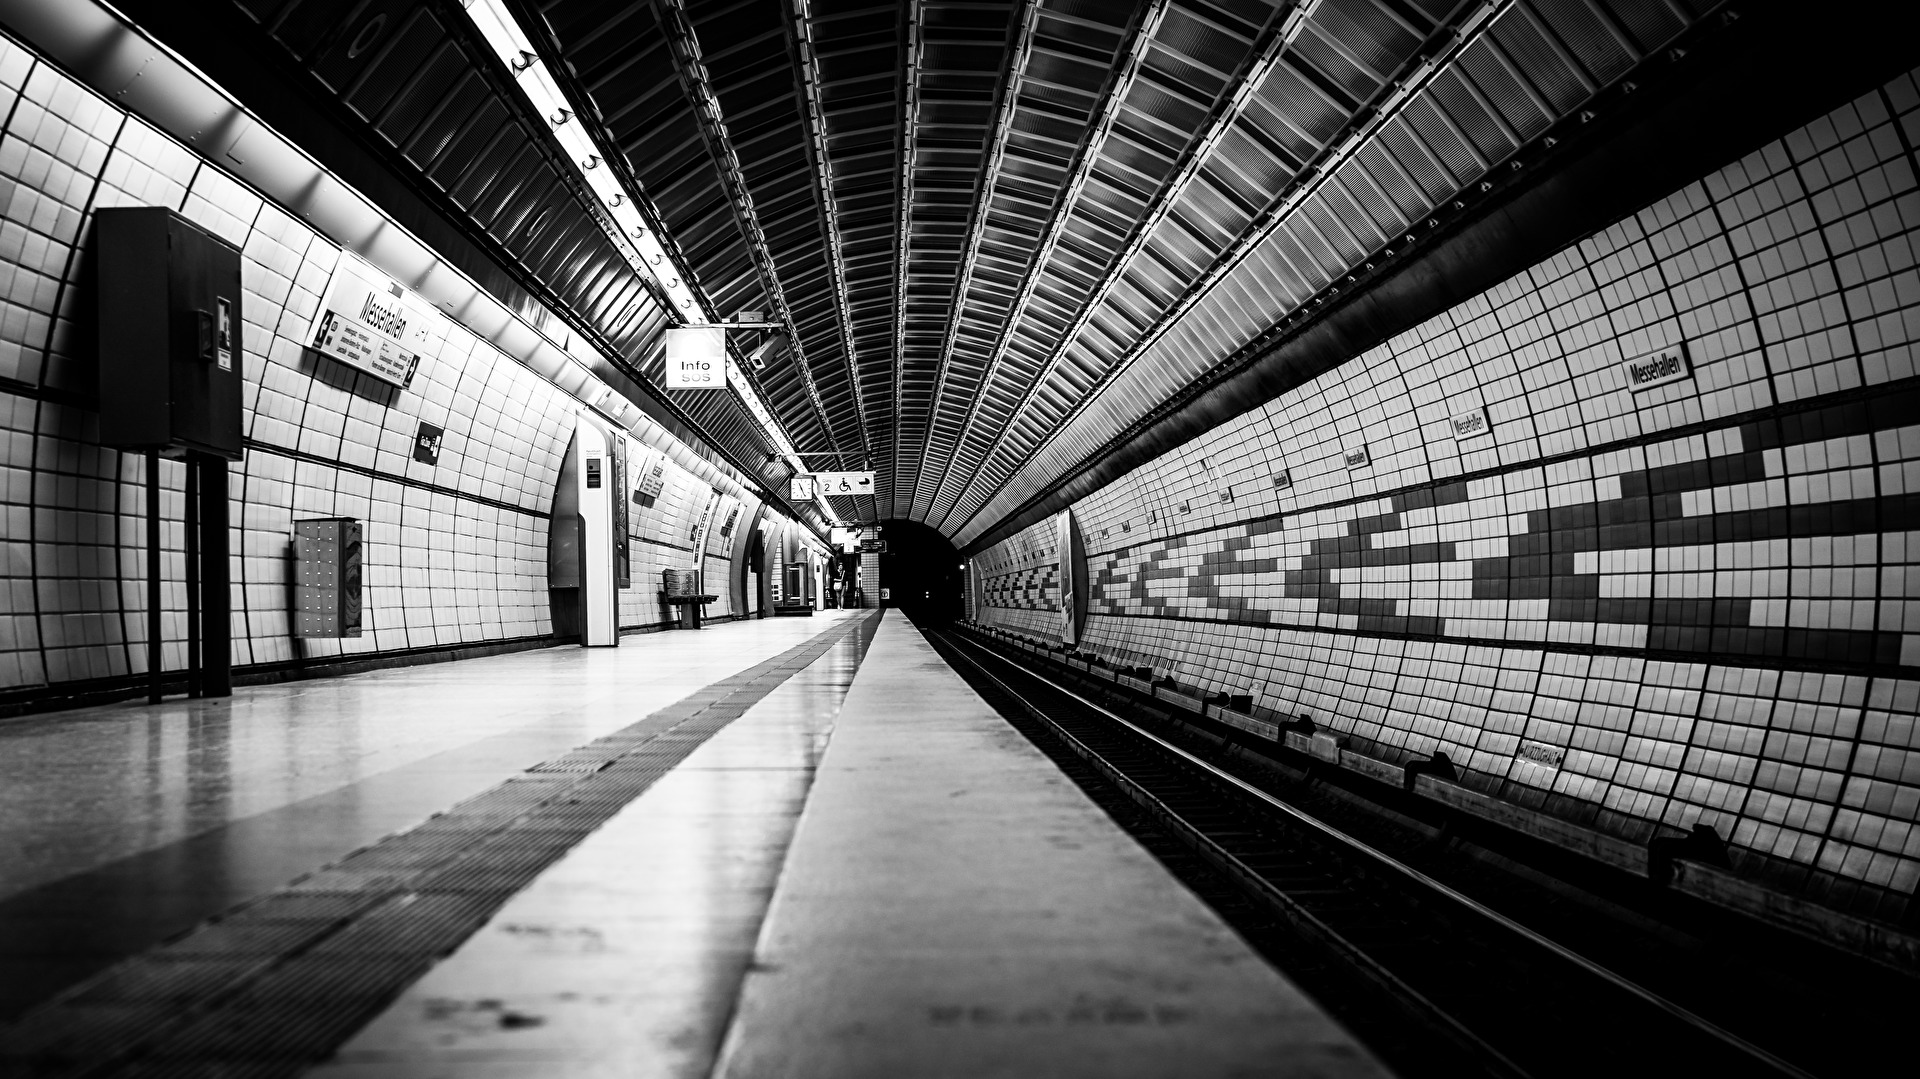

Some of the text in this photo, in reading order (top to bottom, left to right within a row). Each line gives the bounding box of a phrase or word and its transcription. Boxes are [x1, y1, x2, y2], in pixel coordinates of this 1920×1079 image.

[359, 291, 407, 341] Messehallen
[681, 360, 711, 371] Info
[1629, 352, 1681, 385] Messehallen
[681, 373, 711, 383] SOS
[824, 483, 830, 492] 2
